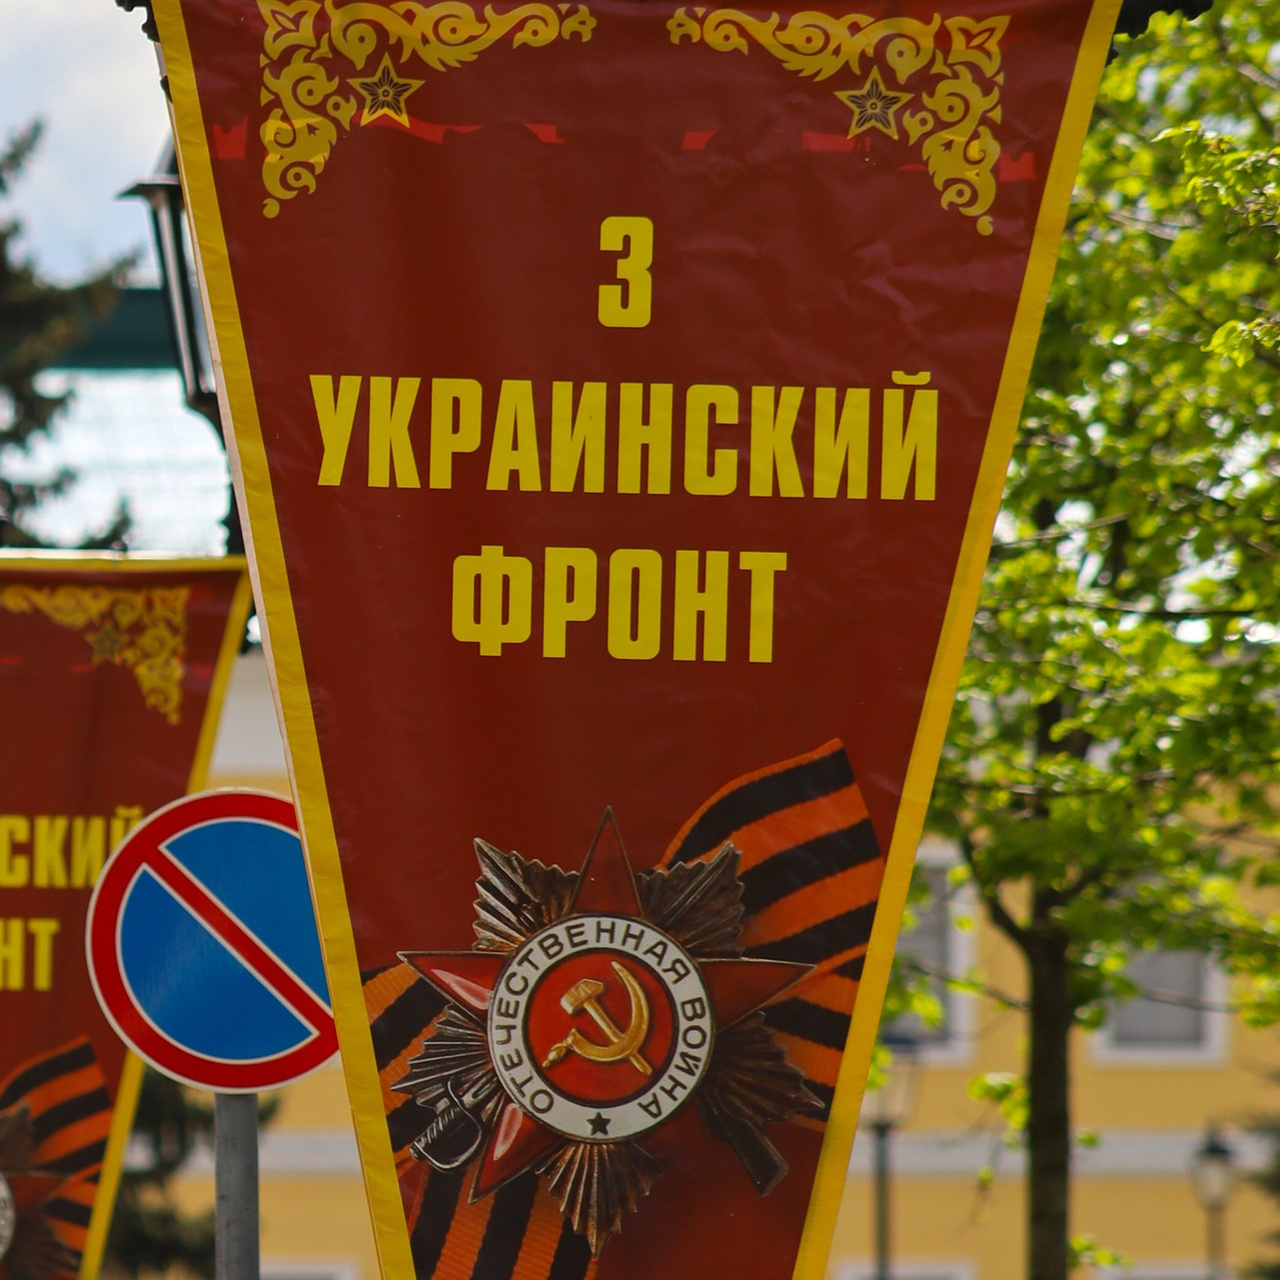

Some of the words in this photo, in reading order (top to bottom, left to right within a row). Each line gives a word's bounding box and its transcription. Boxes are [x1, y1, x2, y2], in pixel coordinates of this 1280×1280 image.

[597, 216, 654, 328] 3
[308, 370, 939, 501] УКРАИНСКИЙ
[451, 545, 788, 663] ФРОНТ
[496, 919, 691, 1114] ОТЕЧЕСТВЕННАЯ
